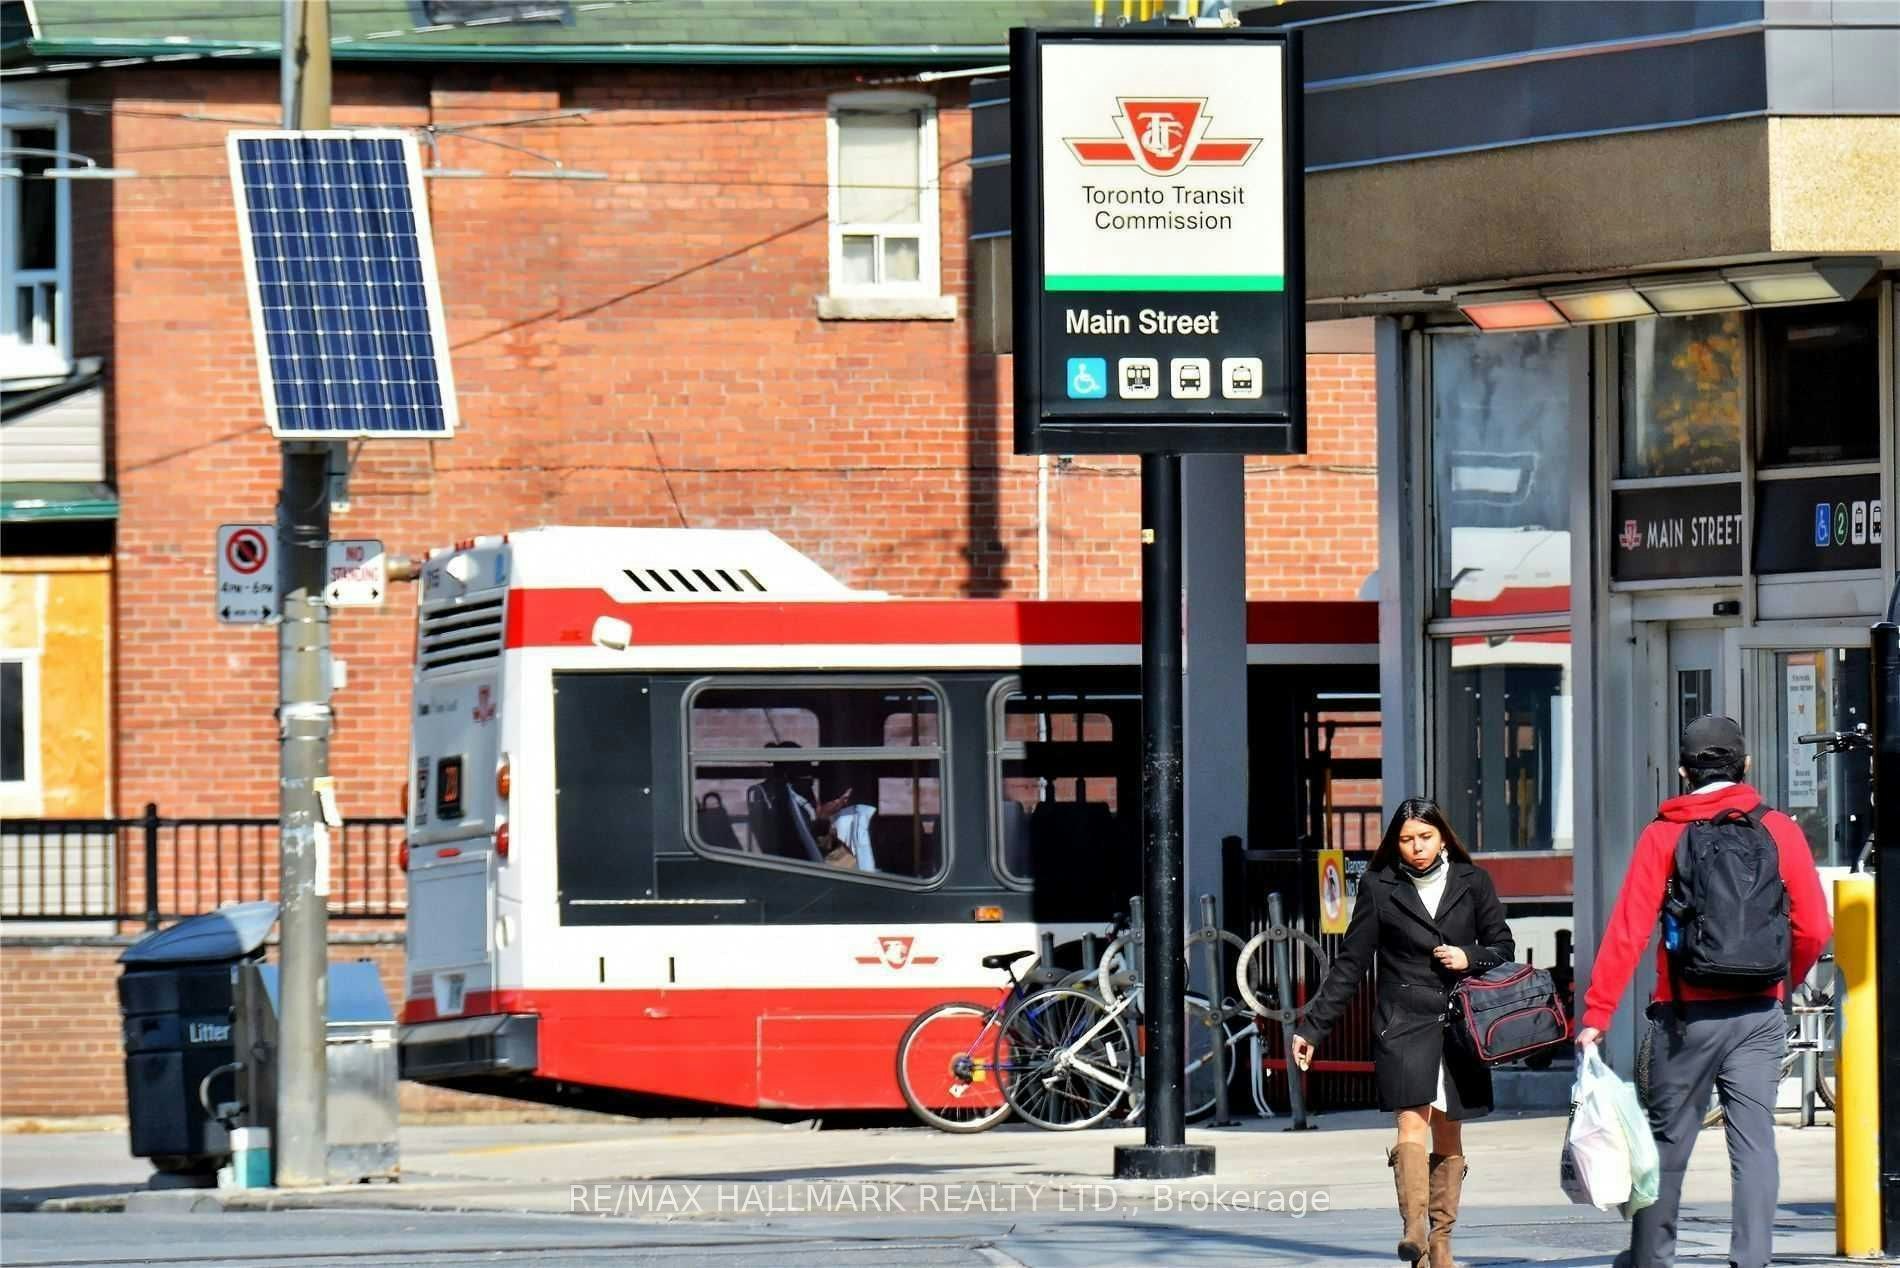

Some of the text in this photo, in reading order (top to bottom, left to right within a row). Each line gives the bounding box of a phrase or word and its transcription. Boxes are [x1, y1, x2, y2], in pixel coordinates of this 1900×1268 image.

[1081, 185, 1245, 205] Toronto Transit
[1095, 210, 1233, 230] Commission
[1065, 308, 1220, 335] Main Street
[1646, 518, 1684, 549] MAIN
[1690, 515, 1743, 547] STREET
[345, 545, 365, 562] NO
[189, 1022, 231, 1044] Litter
